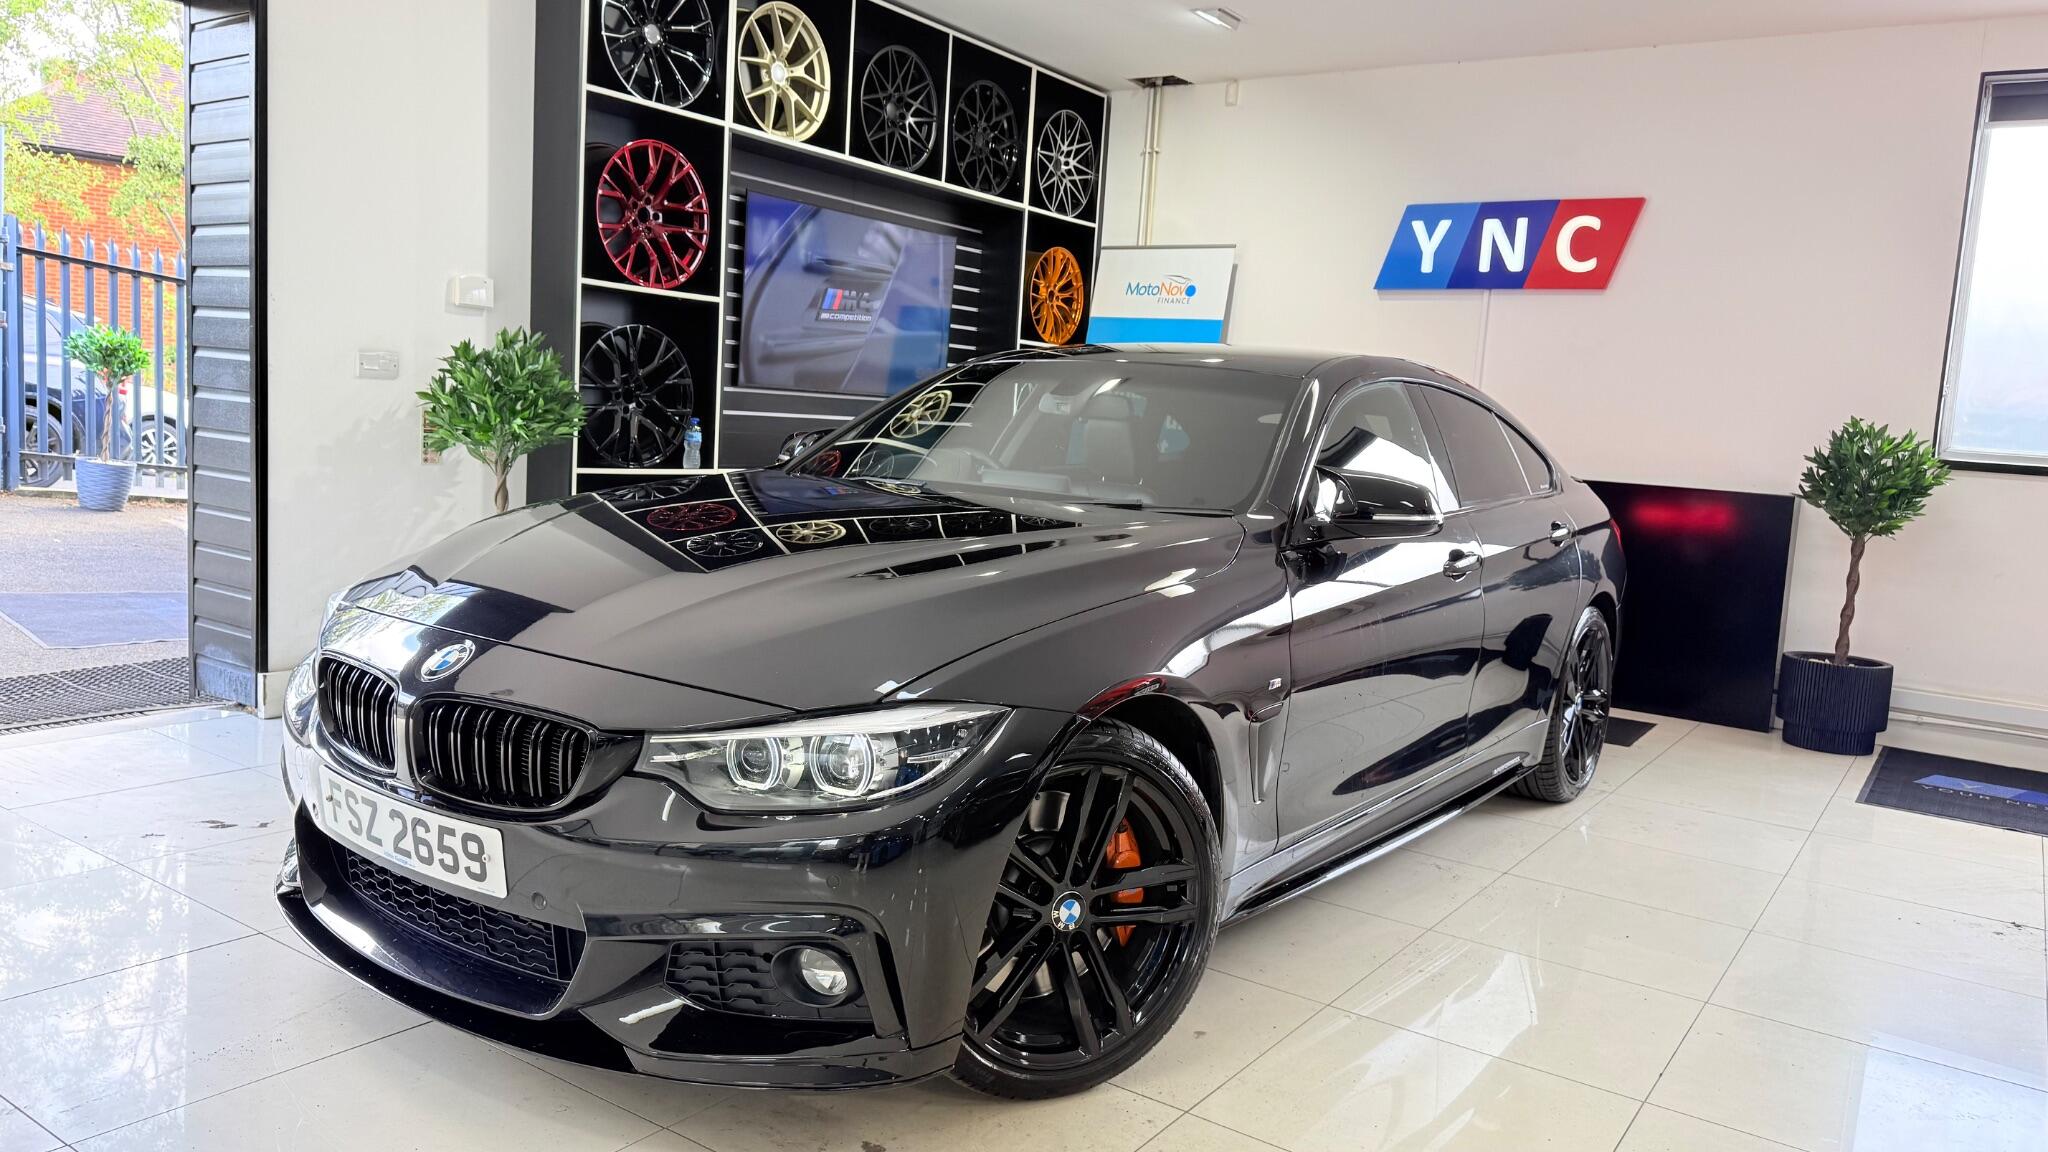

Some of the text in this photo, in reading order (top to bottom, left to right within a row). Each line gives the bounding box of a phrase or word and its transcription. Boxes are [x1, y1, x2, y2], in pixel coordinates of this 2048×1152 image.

[1411, 215, 1601, 274] YNC
[1126, 281, 1196, 297] MotoNovo
[1157, 297, 1191, 305] FINANCE
[328, 778, 488, 883] FSZ 2659
